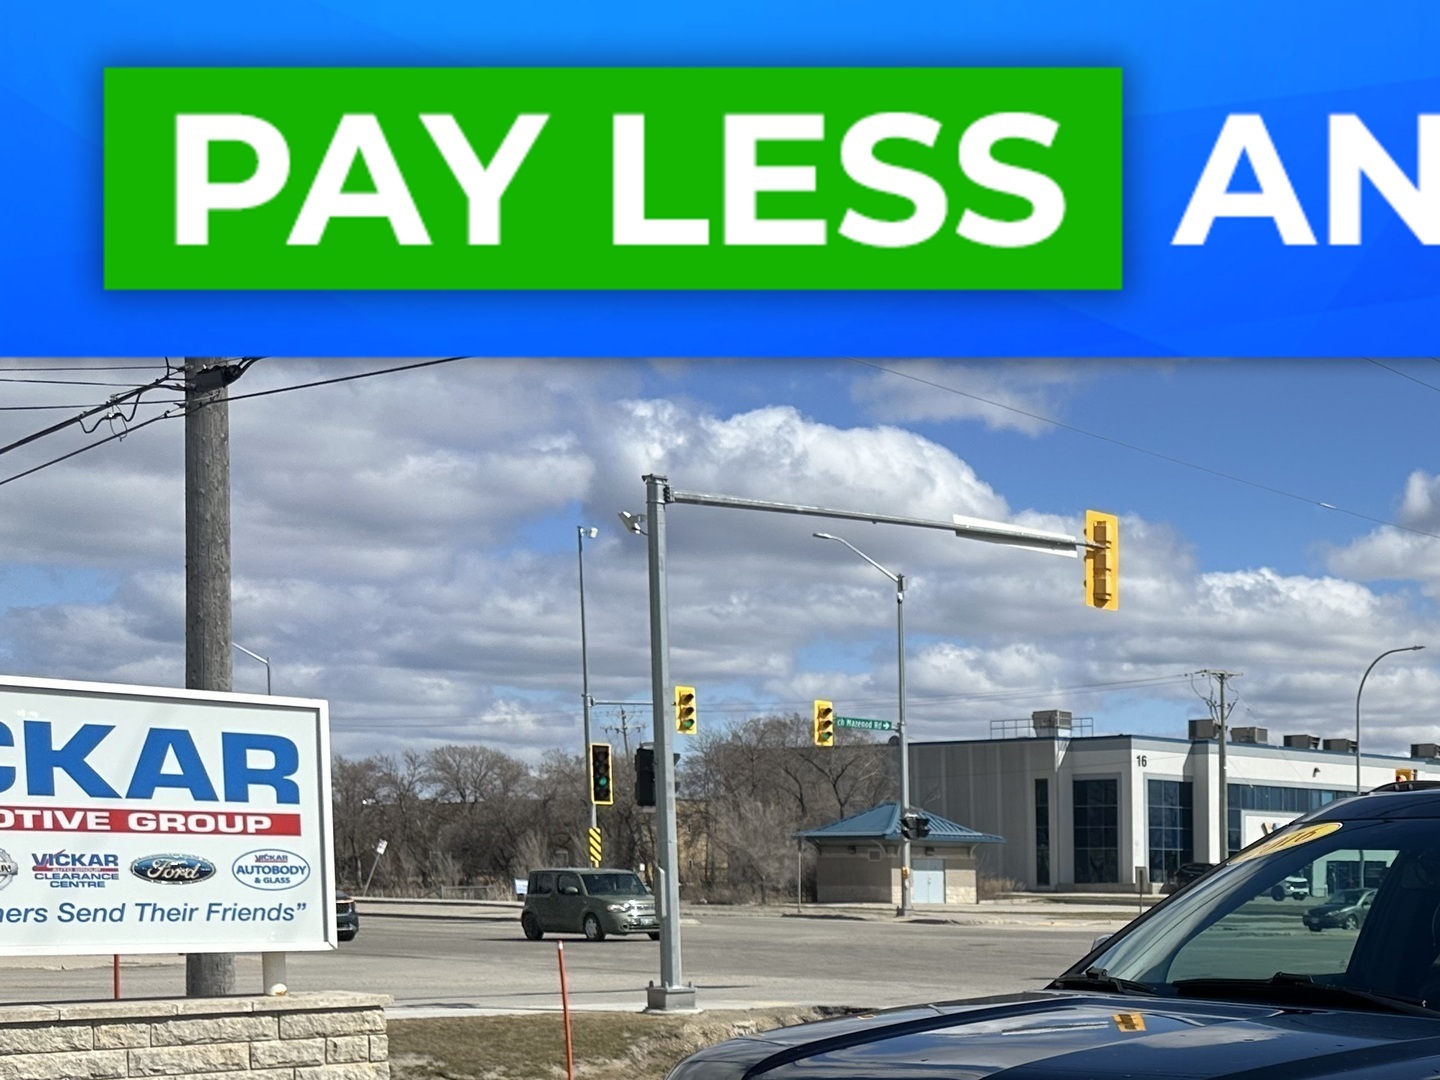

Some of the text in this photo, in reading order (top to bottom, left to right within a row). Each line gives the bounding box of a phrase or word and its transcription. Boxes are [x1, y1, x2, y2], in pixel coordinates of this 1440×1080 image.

[874, 720, 882, 730] Rd
[0, 720, 300, 805] KAR
[1136, 755, 1147, 767] 16
[128, 811, 272, 834] GROUP
[31, 851, 119, 867] VICKAR
[255, 853, 288, 862] VICKAR
[147, 858, 200, 879] Ford
[236, 865, 307, 875] AUTOBODY
[34, 873, 119, 881] CLEARANCE
[49, 880, 106, 888] CENTRE
[57, 902, 126, 923] Send
[135, 902, 199, 922] Their
